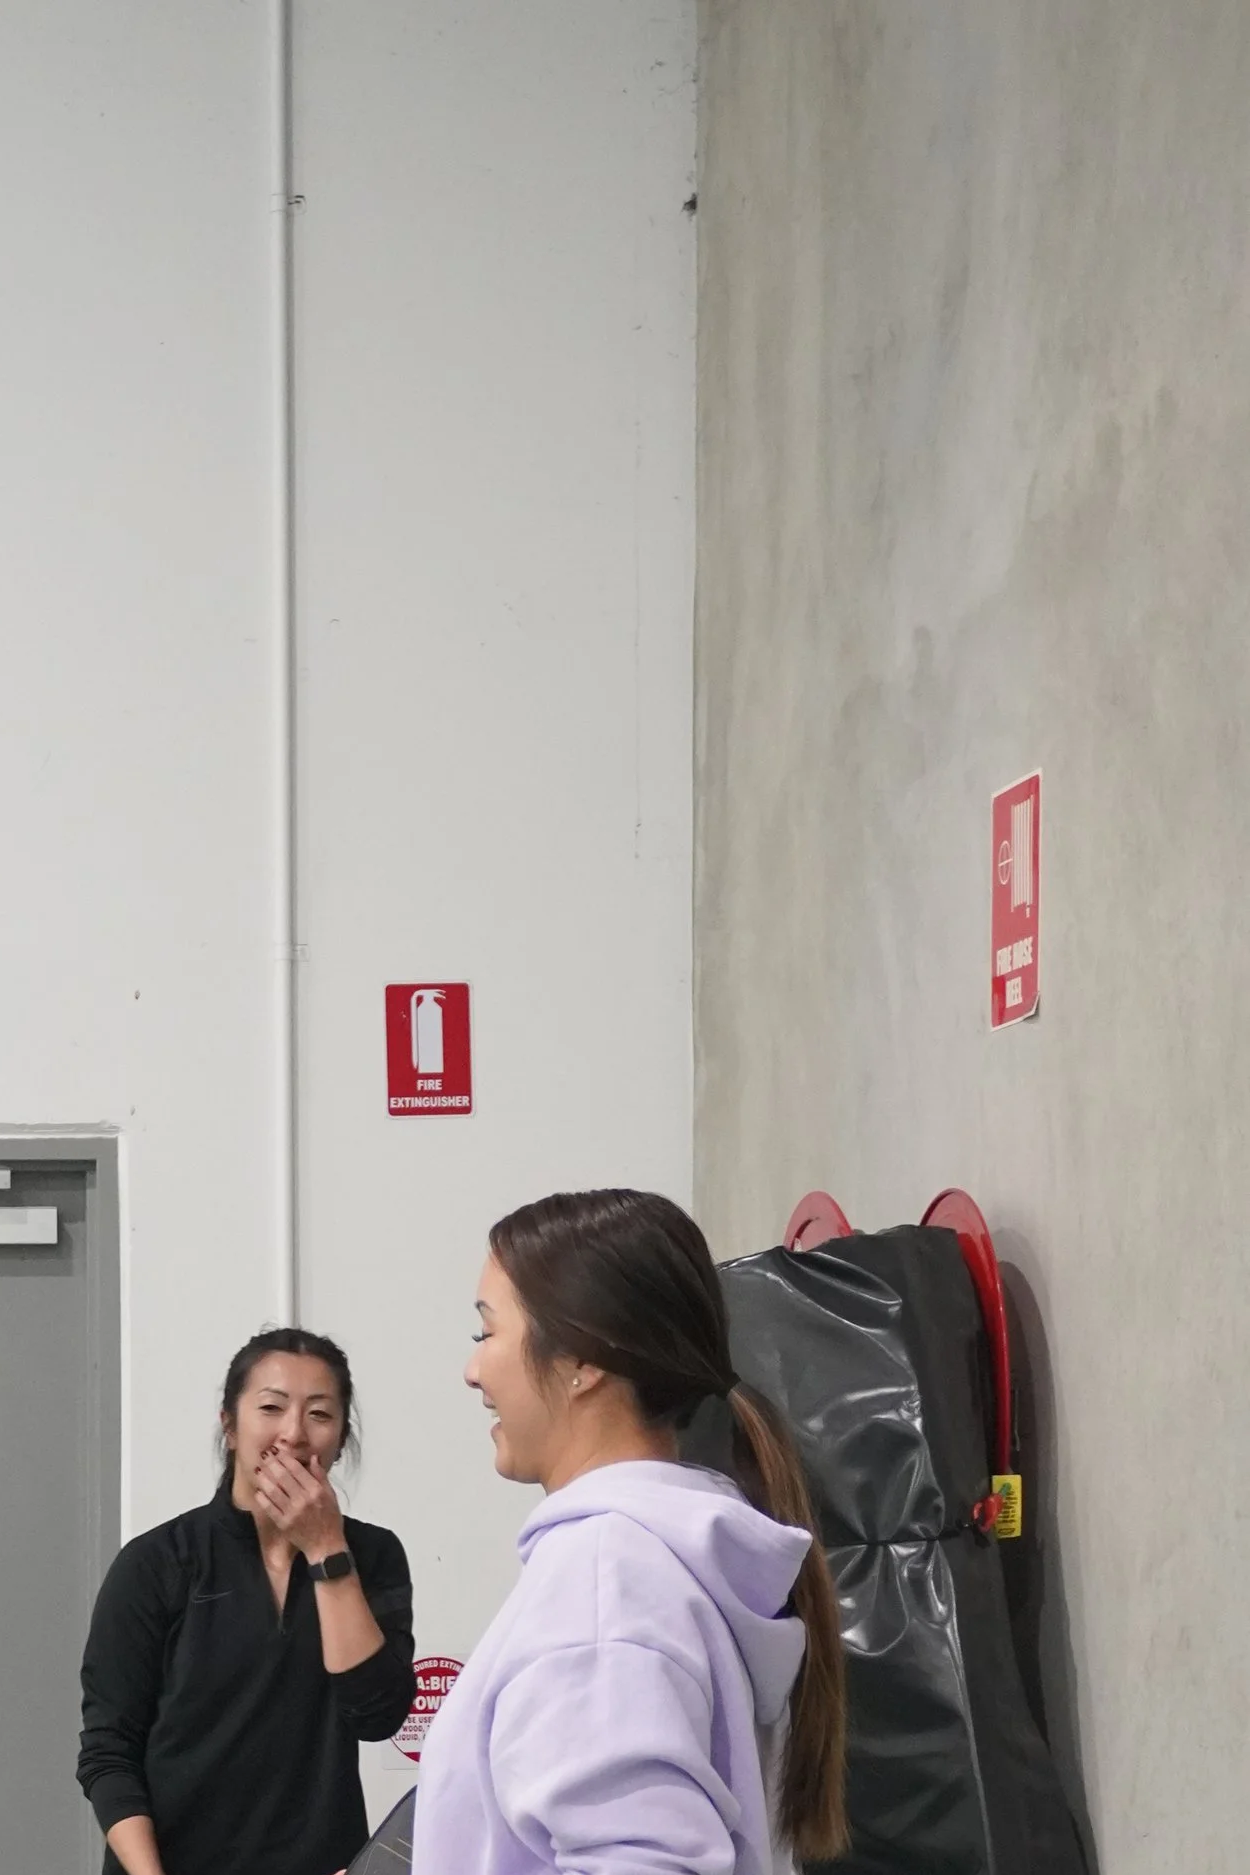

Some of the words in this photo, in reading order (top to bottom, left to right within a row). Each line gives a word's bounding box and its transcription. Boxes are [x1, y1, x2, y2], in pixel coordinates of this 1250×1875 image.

[997, 945, 1012, 977] FIRE
[416, 1079, 443, 1091] FIRE
[389, 1095, 470, 1108] EXTINGUISHER
[413, 1660, 438, 1673] OURED
